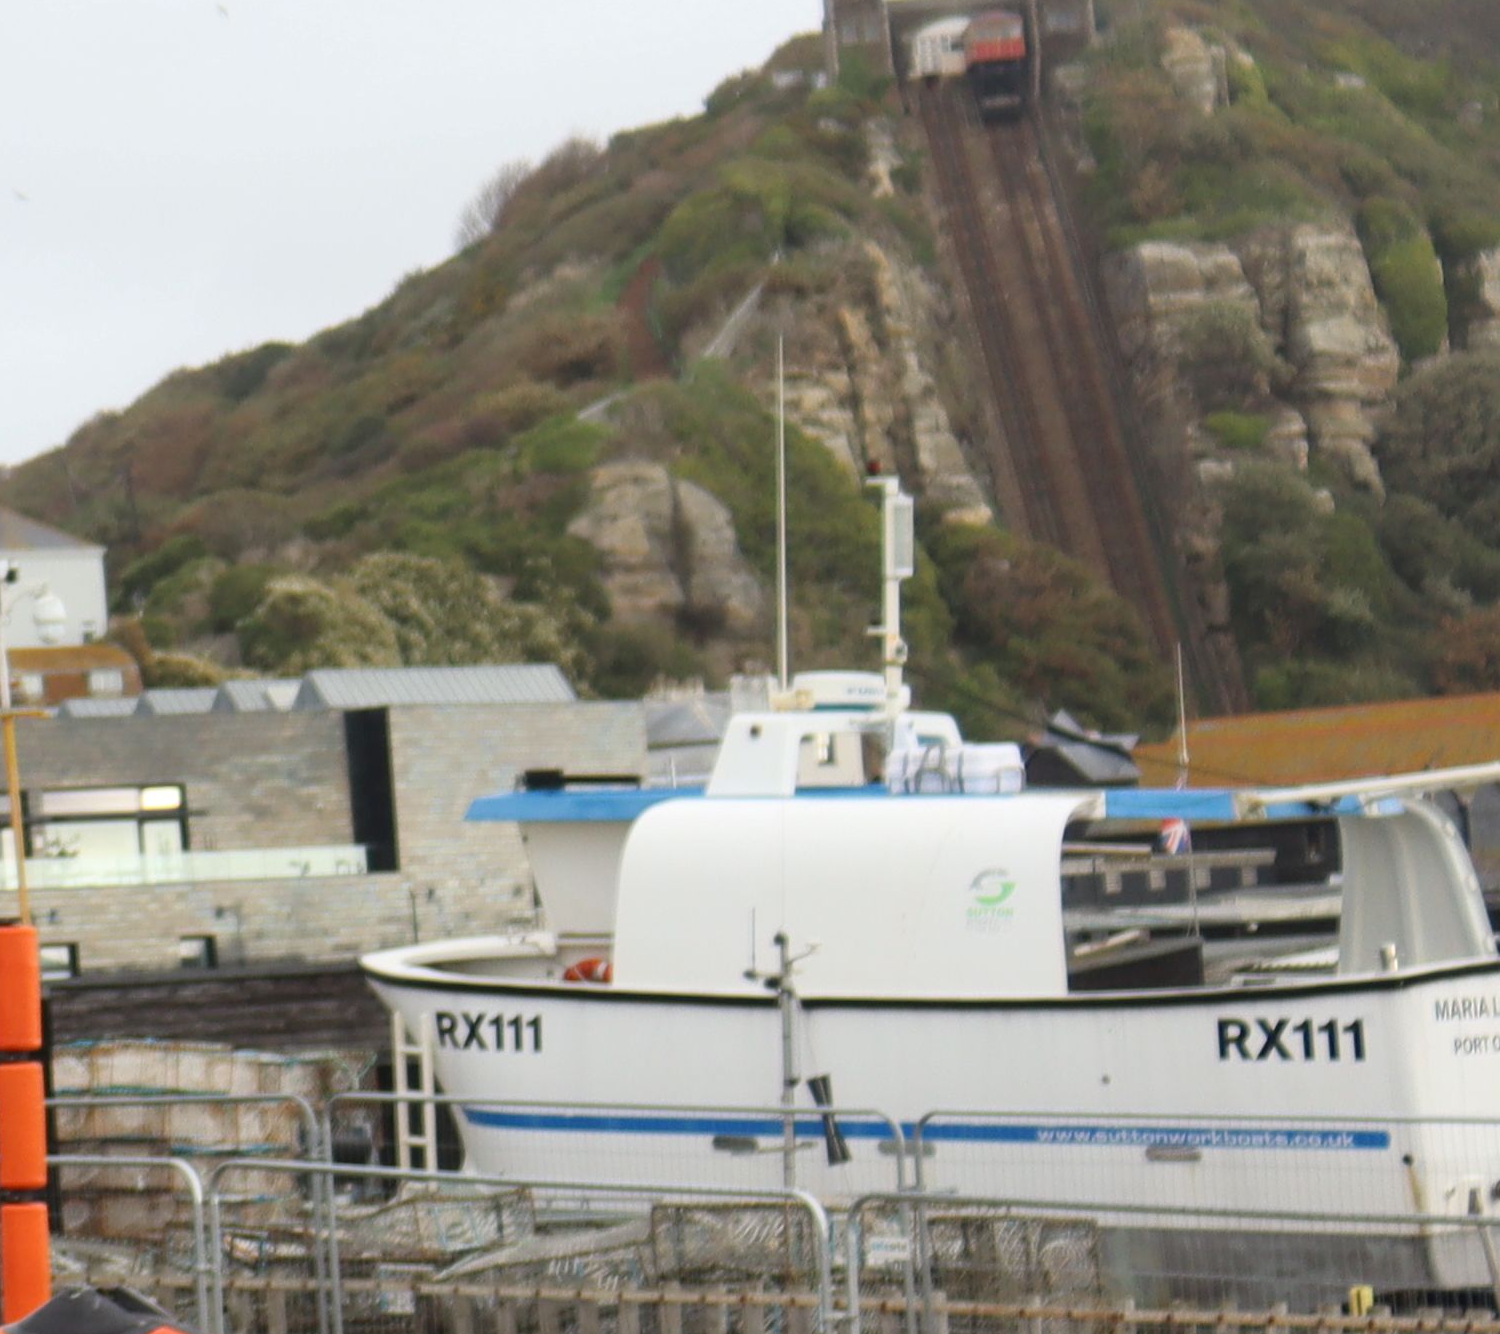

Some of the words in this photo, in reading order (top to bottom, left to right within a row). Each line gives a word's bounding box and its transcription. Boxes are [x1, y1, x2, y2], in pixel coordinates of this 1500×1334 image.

[1435, 996, 1490, 1021] MARIA
[435, 1011, 543, 1052] RX111
[1217, 1017, 1366, 1062] RX111
[1454, 1034, 1488, 1055] PORT
[1036, 1129, 1355, 1148] www.suttonworkboats.co.uk
